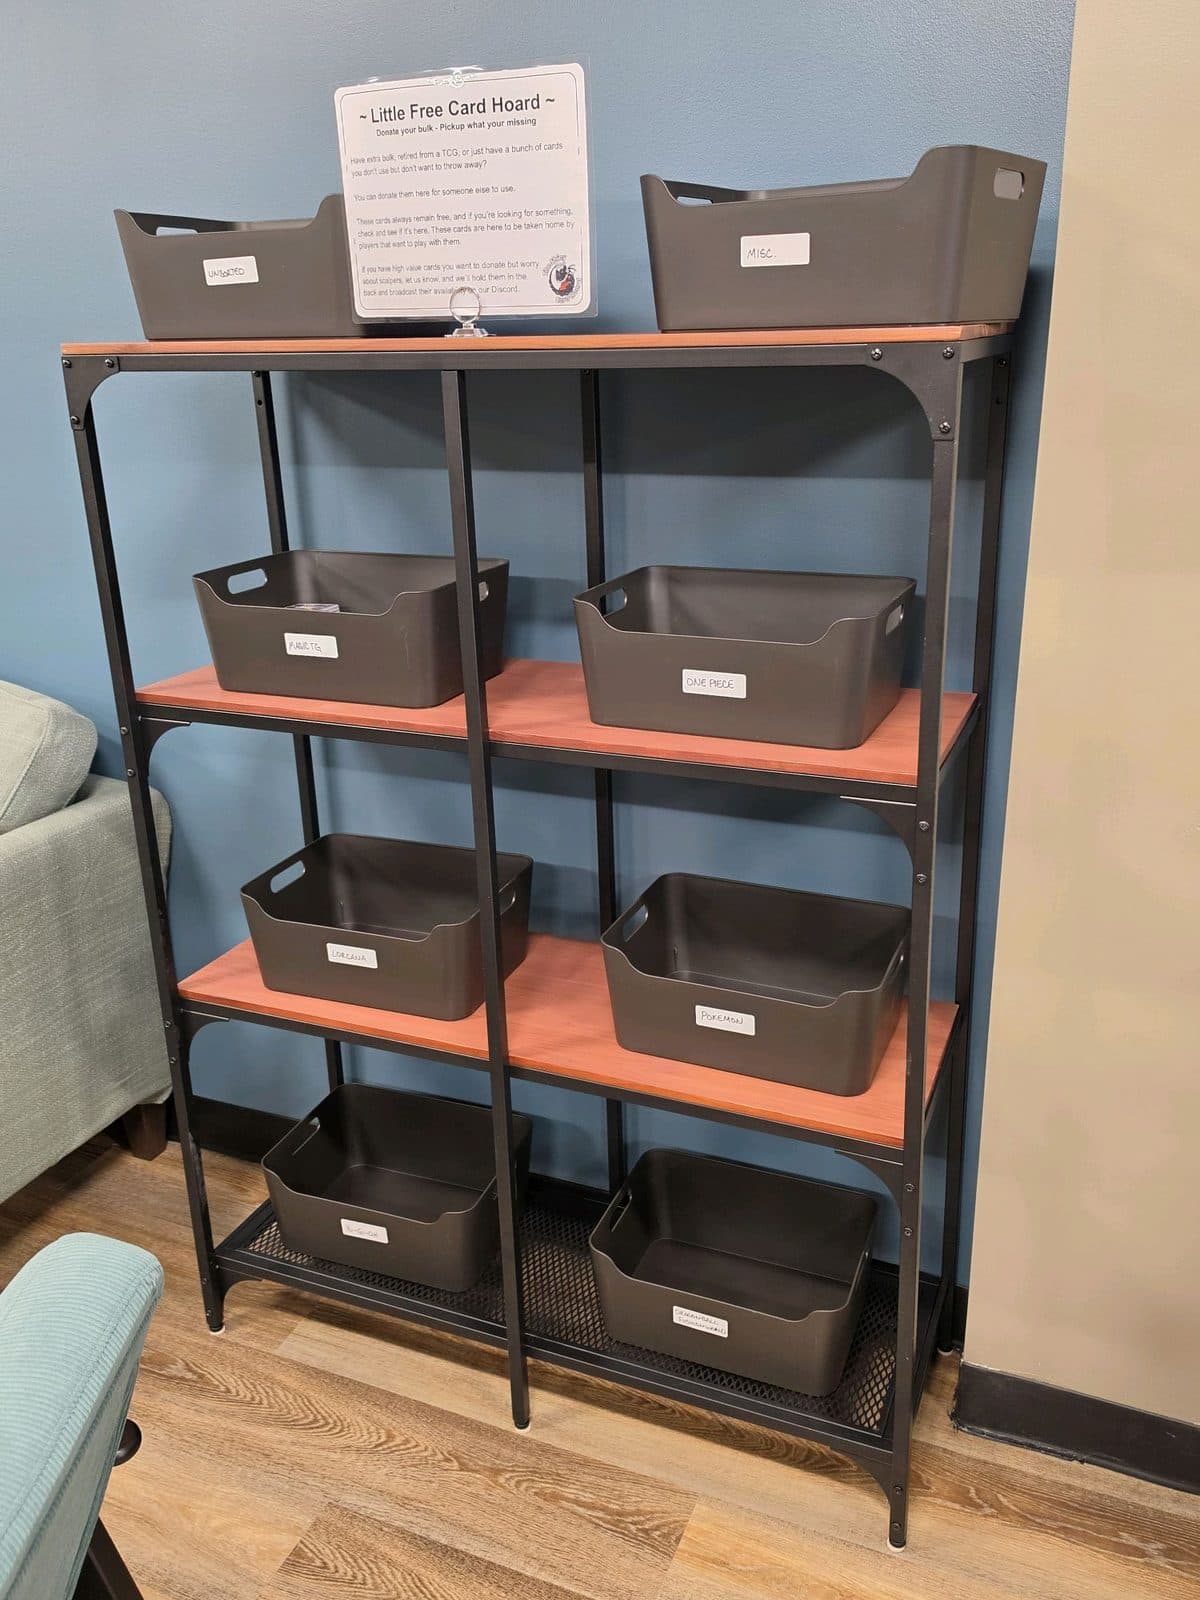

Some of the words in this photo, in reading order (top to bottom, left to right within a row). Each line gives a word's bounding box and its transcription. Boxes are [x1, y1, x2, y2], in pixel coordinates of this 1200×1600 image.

[371, 106, 405, 123] Little
[410, 104, 443, 120] Free
[449, 98, 486, 116] Card
[492, 94, 540, 113] Hoard
[376, 128, 399, 136] Donate
[401, 128, 416, 136] your
[418, 125, 433, 133] bulk
[440, 123, 465, 132] Pickup
[467, 120, 485, 129] what
[487, 121, 504, 130] your
[507, 118, 536, 126] missing
[398, 152, 418, 160] retired
[419, 150, 434, 159] from
[471, 148, 484, 156] just
[486, 146, 503, 154] have
[512, 144, 532, 153] bunch
[534, 143, 542, 151] of
[544, 142, 563, 151] cards
[352, 170, 362, 178] you
[364, 168, 378, 176] don't
[390, 166, 400, 174] but
[402, 164, 417, 172] don't
[418, 164, 434, 172] want
[444, 161, 462, 170] throw
[464, 160, 488, 170] away?
[354, 194, 365, 202] You
[378, 192, 398, 200] donate
[399, 190, 415, 198] them
[416, 190, 430, 198] here
[432, 188, 440, 196] for
[442, 188, 474, 196] someone
[476, 186, 490, 194] else
[356, 217, 374, 225] These
[376, 216, 390, 224] cards
[392, 216, 412, 224] always
[414, 214, 434, 222] remain
[454, 212, 466, 220] and
[468, 211, 472, 219] if
[474, 211, 496, 220] you're
[497, 210, 522, 220] looking
[524, 208, 534, 217] for
[358, 230, 374, 238] check
[376, 230, 386, 238] and
[414, 227, 429, 236] here.
[431, 226, 451, 234] These
[453, 224, 471, 233] cards
[486, 224, 502, 232] here
[513, 222, 522, 230] be
[524, 222, 543, 230] taken
[545, 220, 564, 228] home
[566, 220, 575, 230] by
[358, 242, 378, 250] players
[380, 240, 391, 248] that
[407, 240, 414, 248] to
[414, 240, 427, 249] play
[429, 238, 442, 246] with
[747, 248, 776, 259] MISC.
[367, 267, 376, 276] you
[378, 266, 391, 274] have
[392, 264, 404, 274] high
[406, 264, 421, 272] value
[424, 262, 440, 272] cards
[442, 264, 454, 272] you
[456, 262, 472, 270] want
[473, 262, 480, 270] to
[482, 260, 506, 269] donate
[508, 260, 518, 268] but
[520, 260, 540, 270] worry
[364, 278, 378, 286] about
[442, 274, 454, 282] and
[472, 273, 486, 282] hold
[488, 272, 505, 281] them
[508, 272, 514, 280] in
[516, 272, 526, 280] the
[364, 288, 376, 296] back
[378, 288, 388, 296] and
[390, 288, 417, 296] broadcast
[419, 287, 432, 295] their
[686, 678, 706, 687] ONE
[710, 678, 734, 689] PIECE
[702, 1010, 744, 1024] POKEMON
